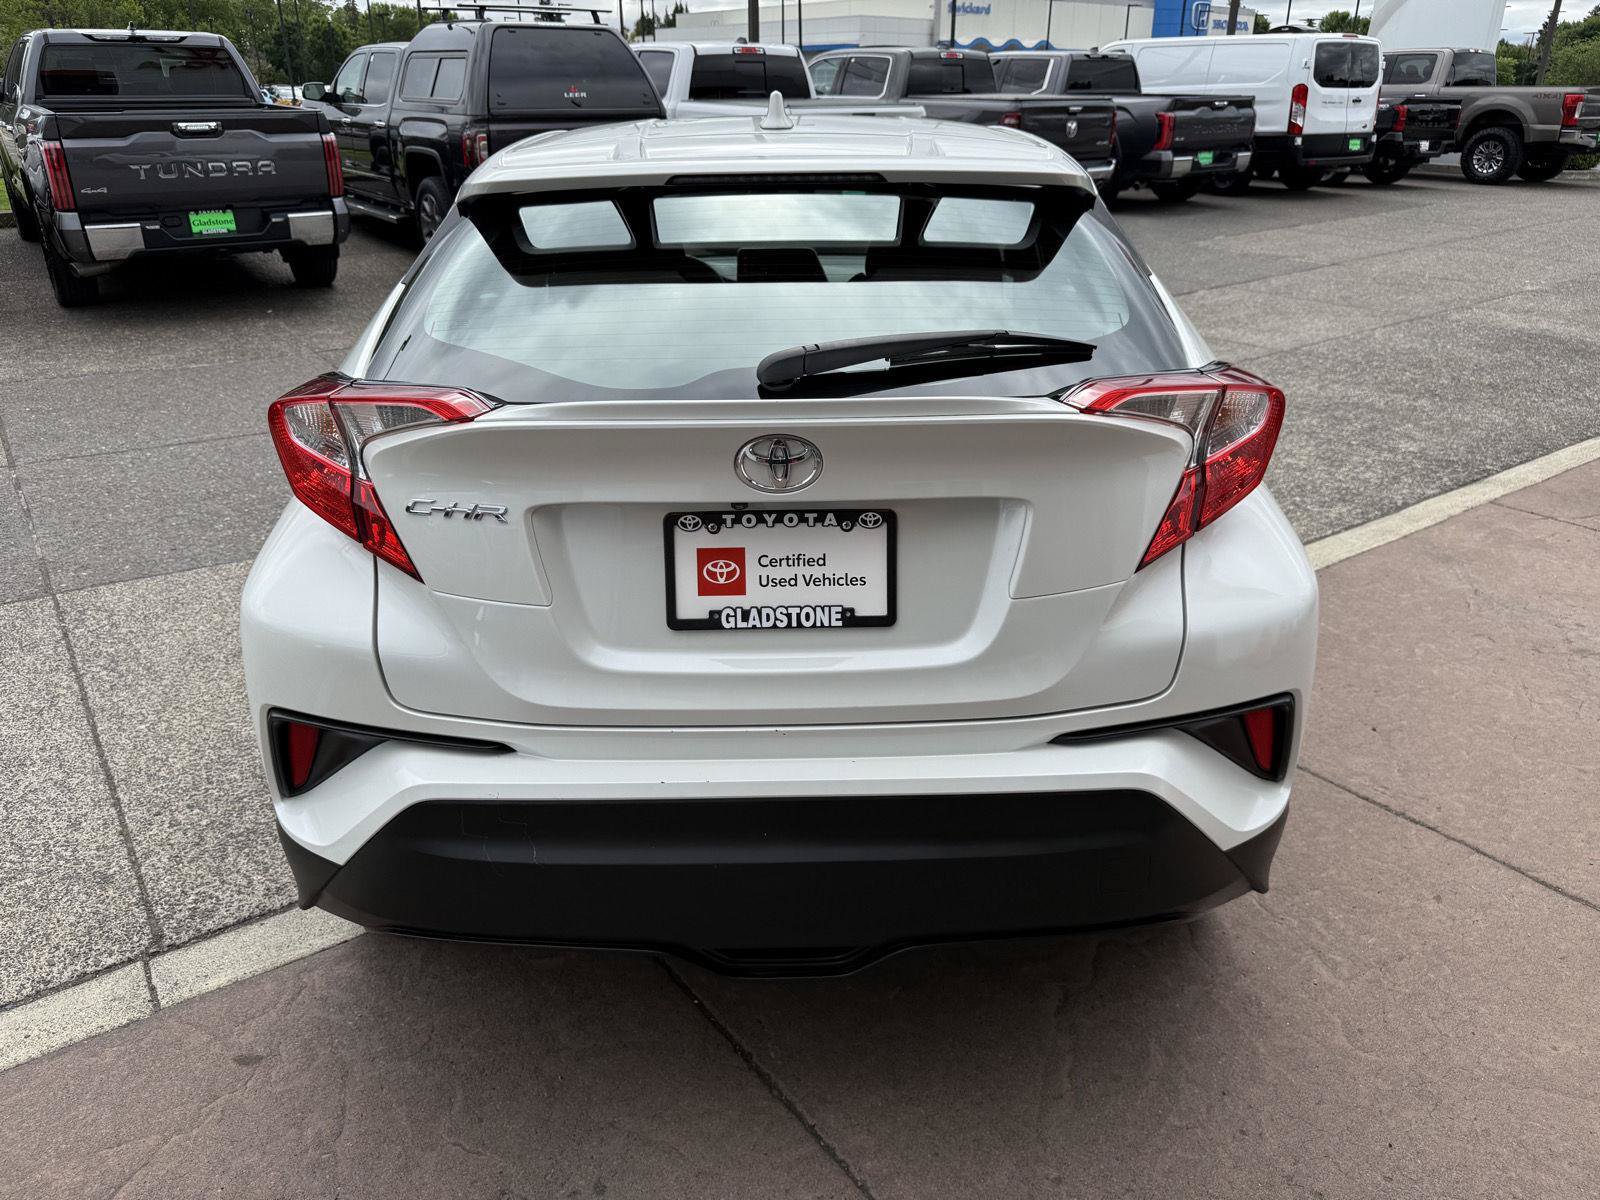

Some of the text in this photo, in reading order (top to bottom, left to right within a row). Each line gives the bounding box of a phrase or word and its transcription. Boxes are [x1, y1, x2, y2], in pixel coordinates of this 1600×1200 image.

[1212, 19, 1249, 31] HODA
[129, 160, 277, 180] TUNDRA
[192, 217, 235, 227] Gladstone
[722, 512, 838, 529] TOYOTA
[757, 553, 827, 568] Certified
[758, 573, 867, 588] Used Vehicles
[720, 606, 843, 629] GLADSTONE
